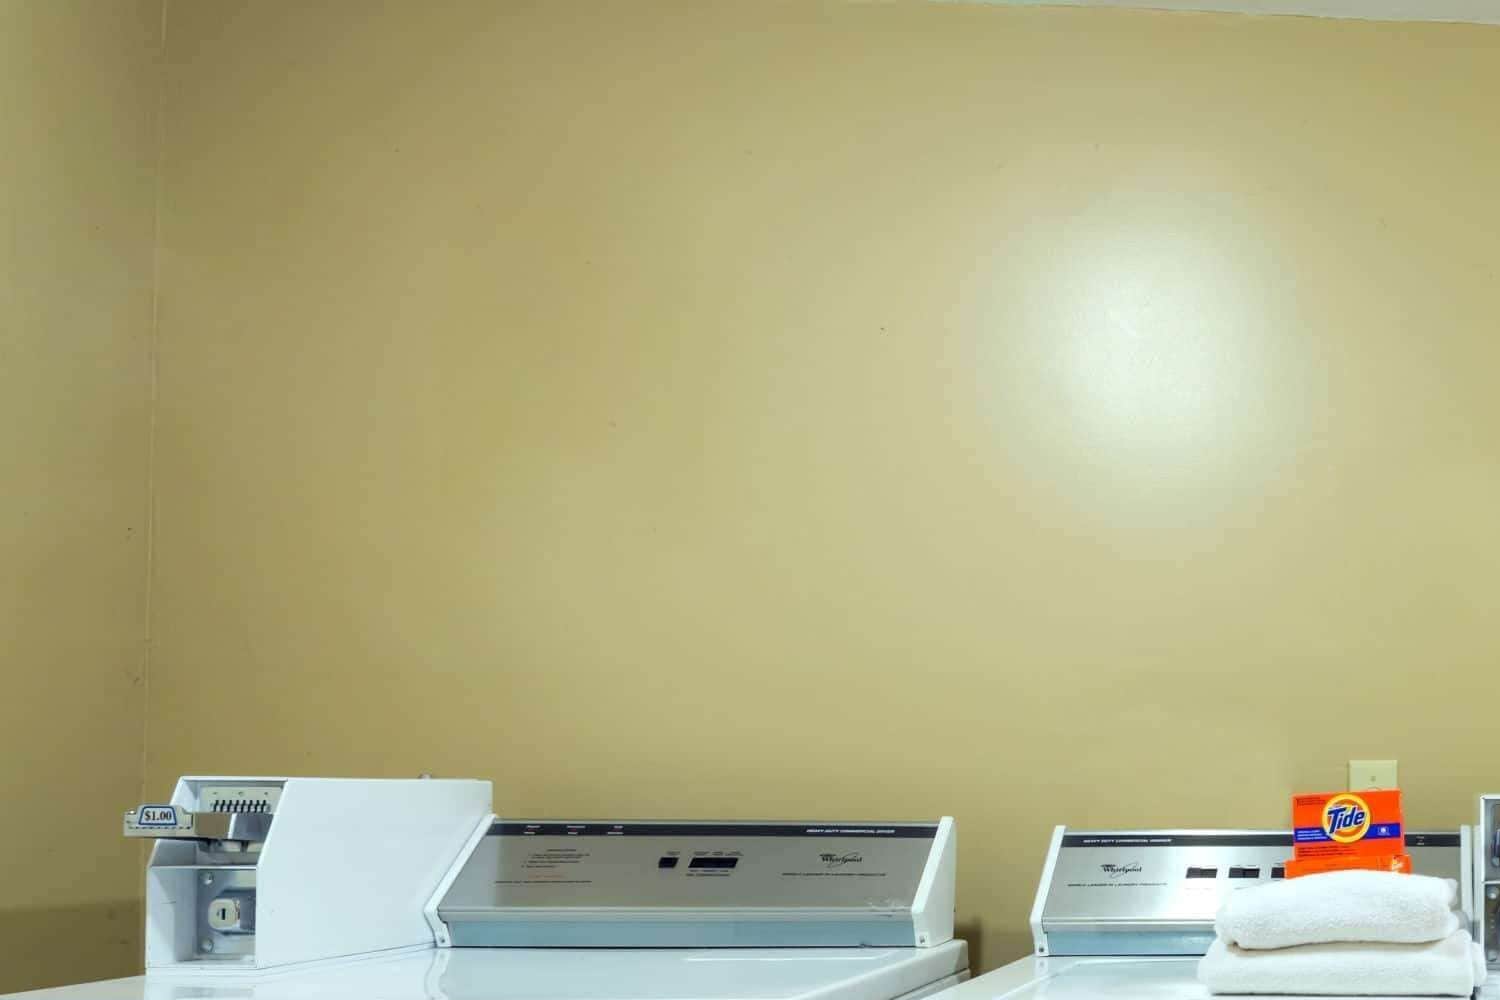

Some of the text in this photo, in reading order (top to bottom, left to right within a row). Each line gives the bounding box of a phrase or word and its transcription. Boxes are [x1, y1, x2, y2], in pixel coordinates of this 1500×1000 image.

[144, 810, 172, 821] $1.00
[1328, 805, 1365, 834] Tide
[1101, 863, 1142, 876] Whirlpool
